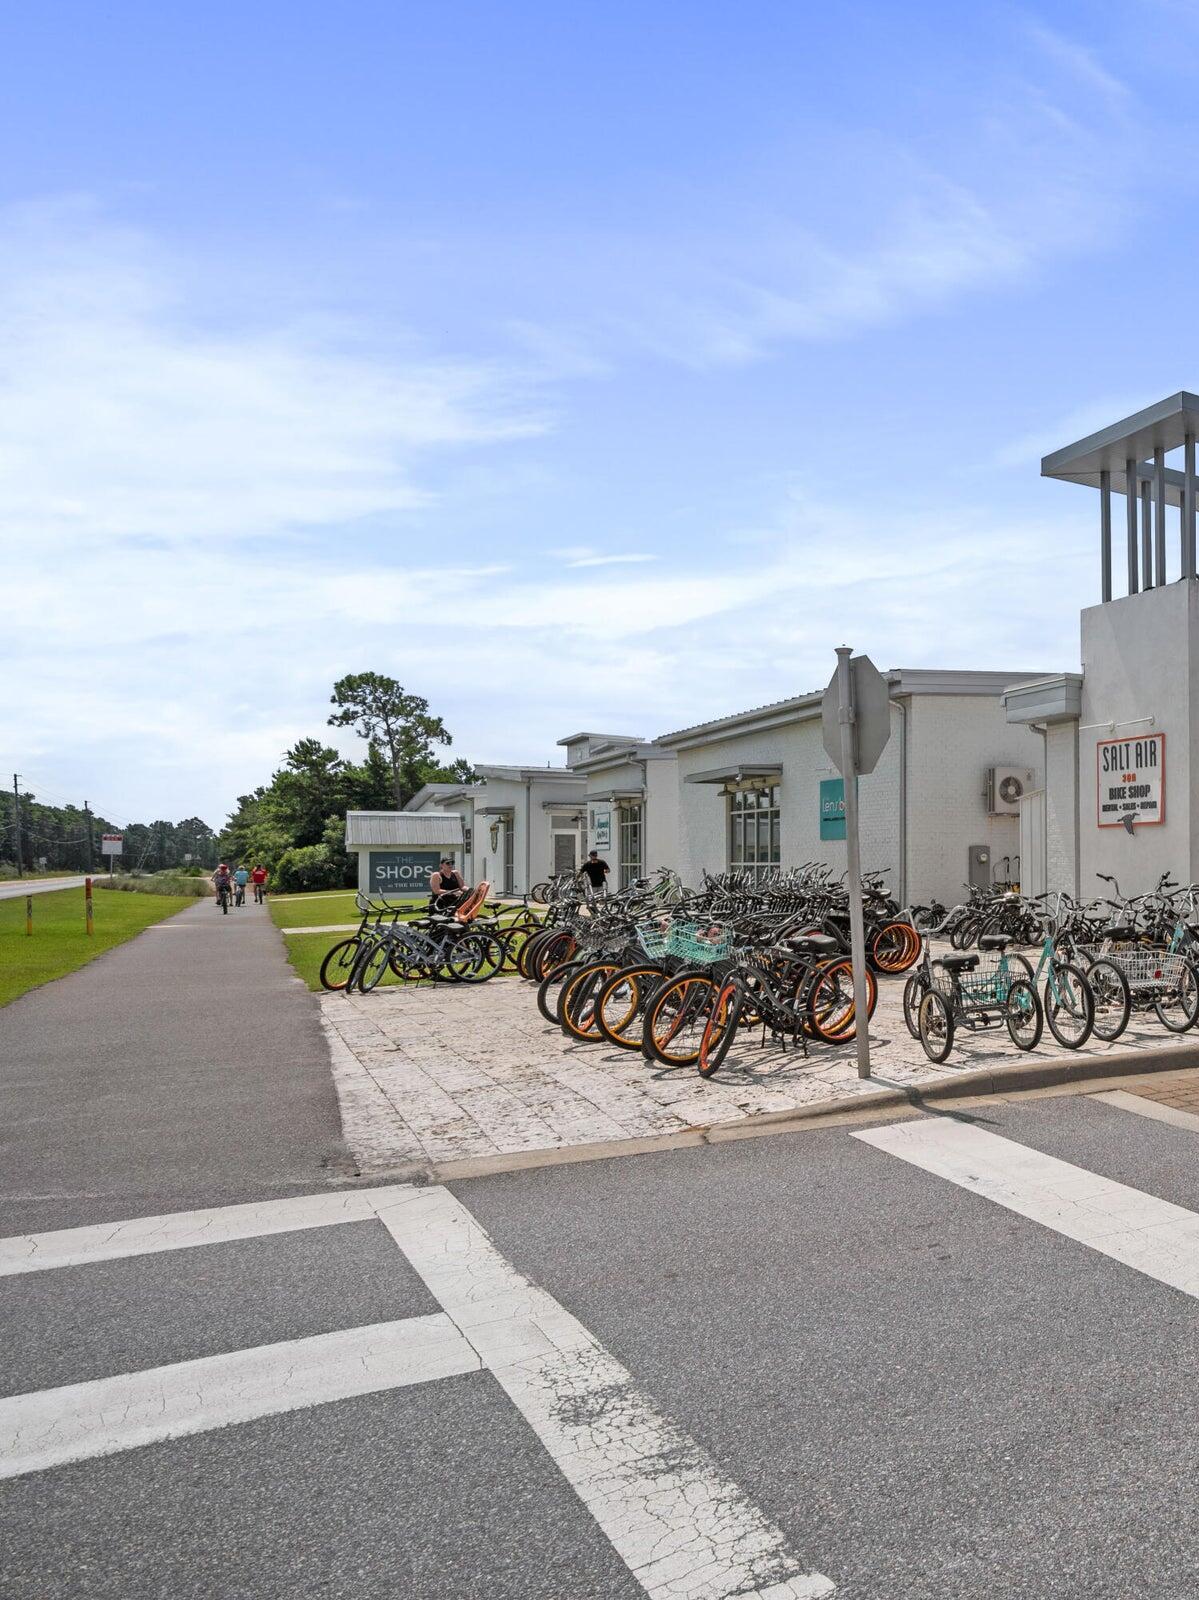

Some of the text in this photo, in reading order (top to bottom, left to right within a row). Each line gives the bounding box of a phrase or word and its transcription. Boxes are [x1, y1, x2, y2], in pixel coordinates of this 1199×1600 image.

[1102, 740, 1157, 772] SALT AIR
[1109, 784, 1151, 800] BIKE SHOP
[395, 856, 414, 864] THE
[375, 865, 434, 879] SHOPS
